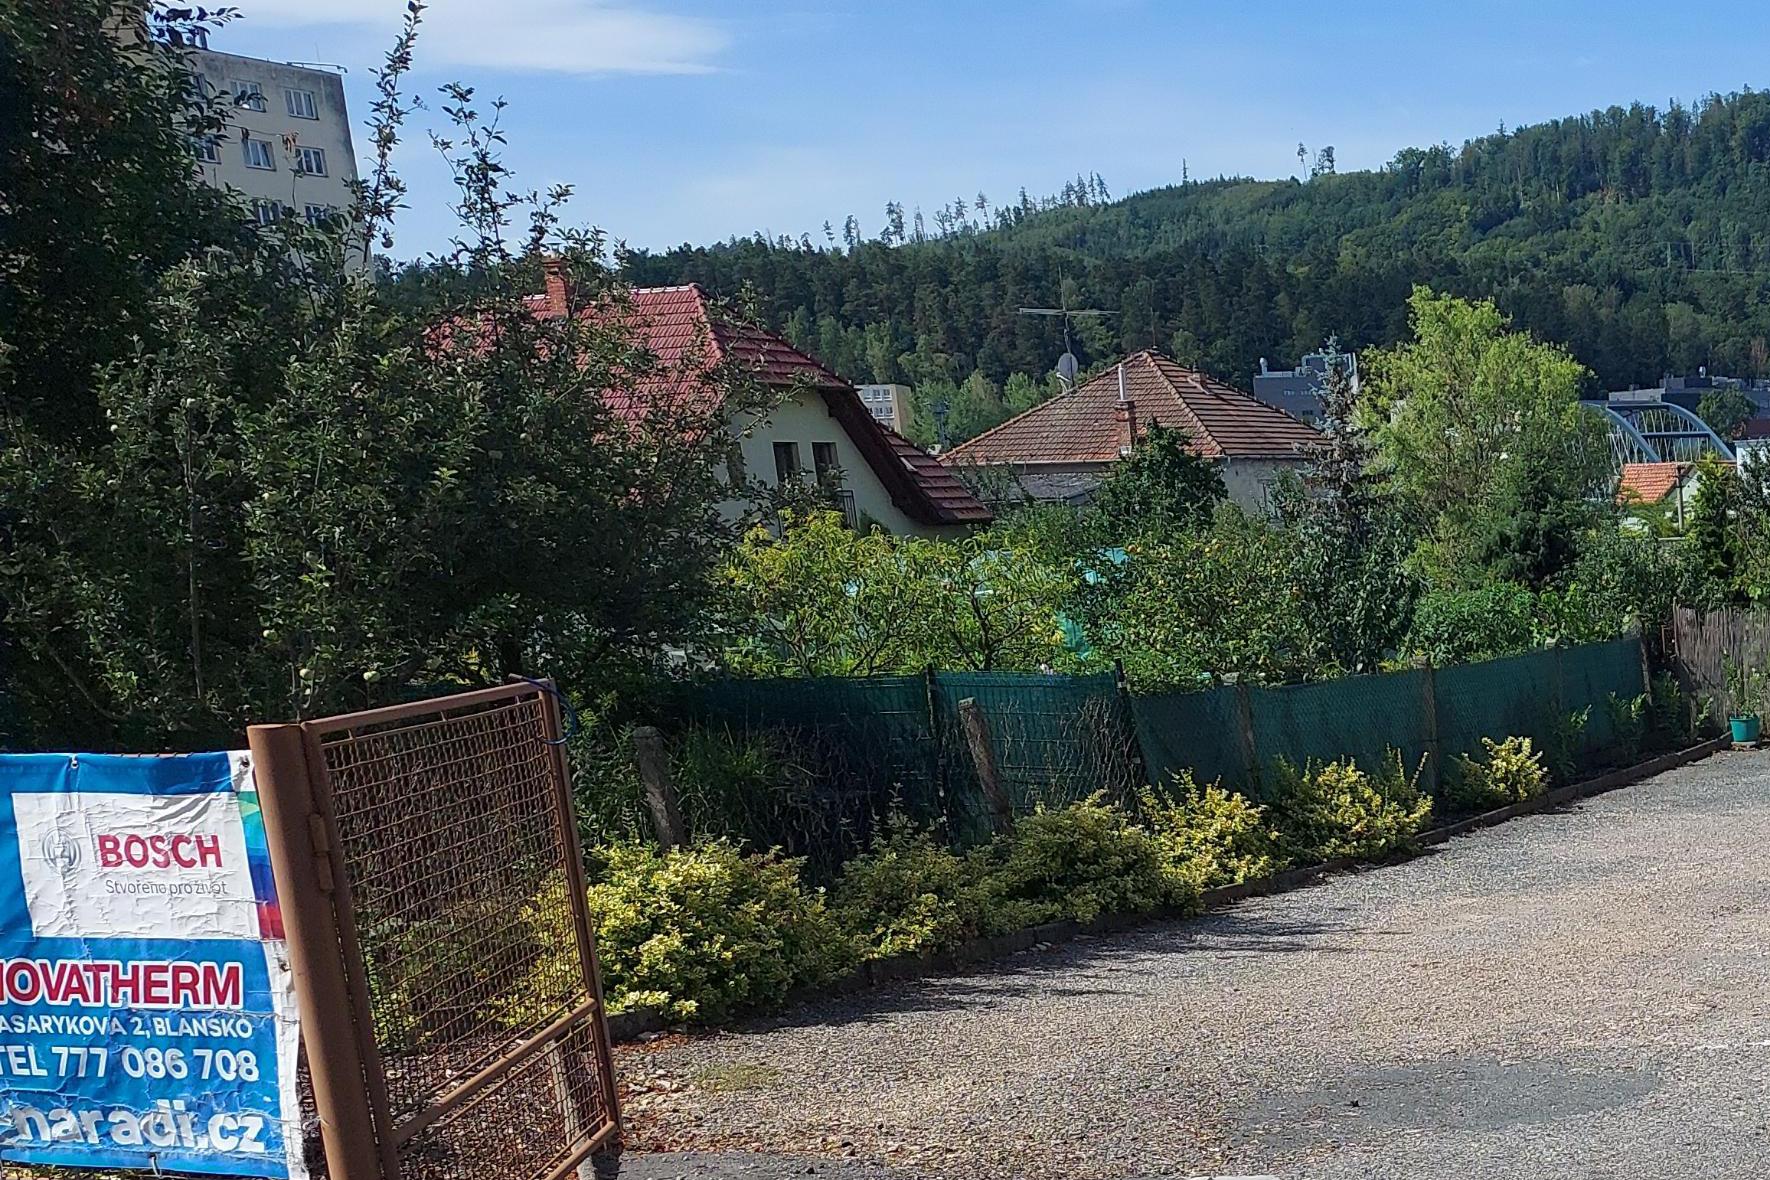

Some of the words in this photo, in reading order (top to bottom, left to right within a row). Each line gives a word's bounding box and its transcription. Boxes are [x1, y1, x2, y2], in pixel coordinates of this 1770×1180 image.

[98, 834, 222, 868] BOSCH
[170, 883, 192, 897] pro
[0, 961, 241, 1005] OVATHERM
[130, 1016, 150, 1039] 2,
[153, 1017, 253, 1038] BLANSKO
[52, 1046, 107, 1077] 777
[121, 1047, 188, 1079] 086
[193, 1048, 260, 1082] 708
